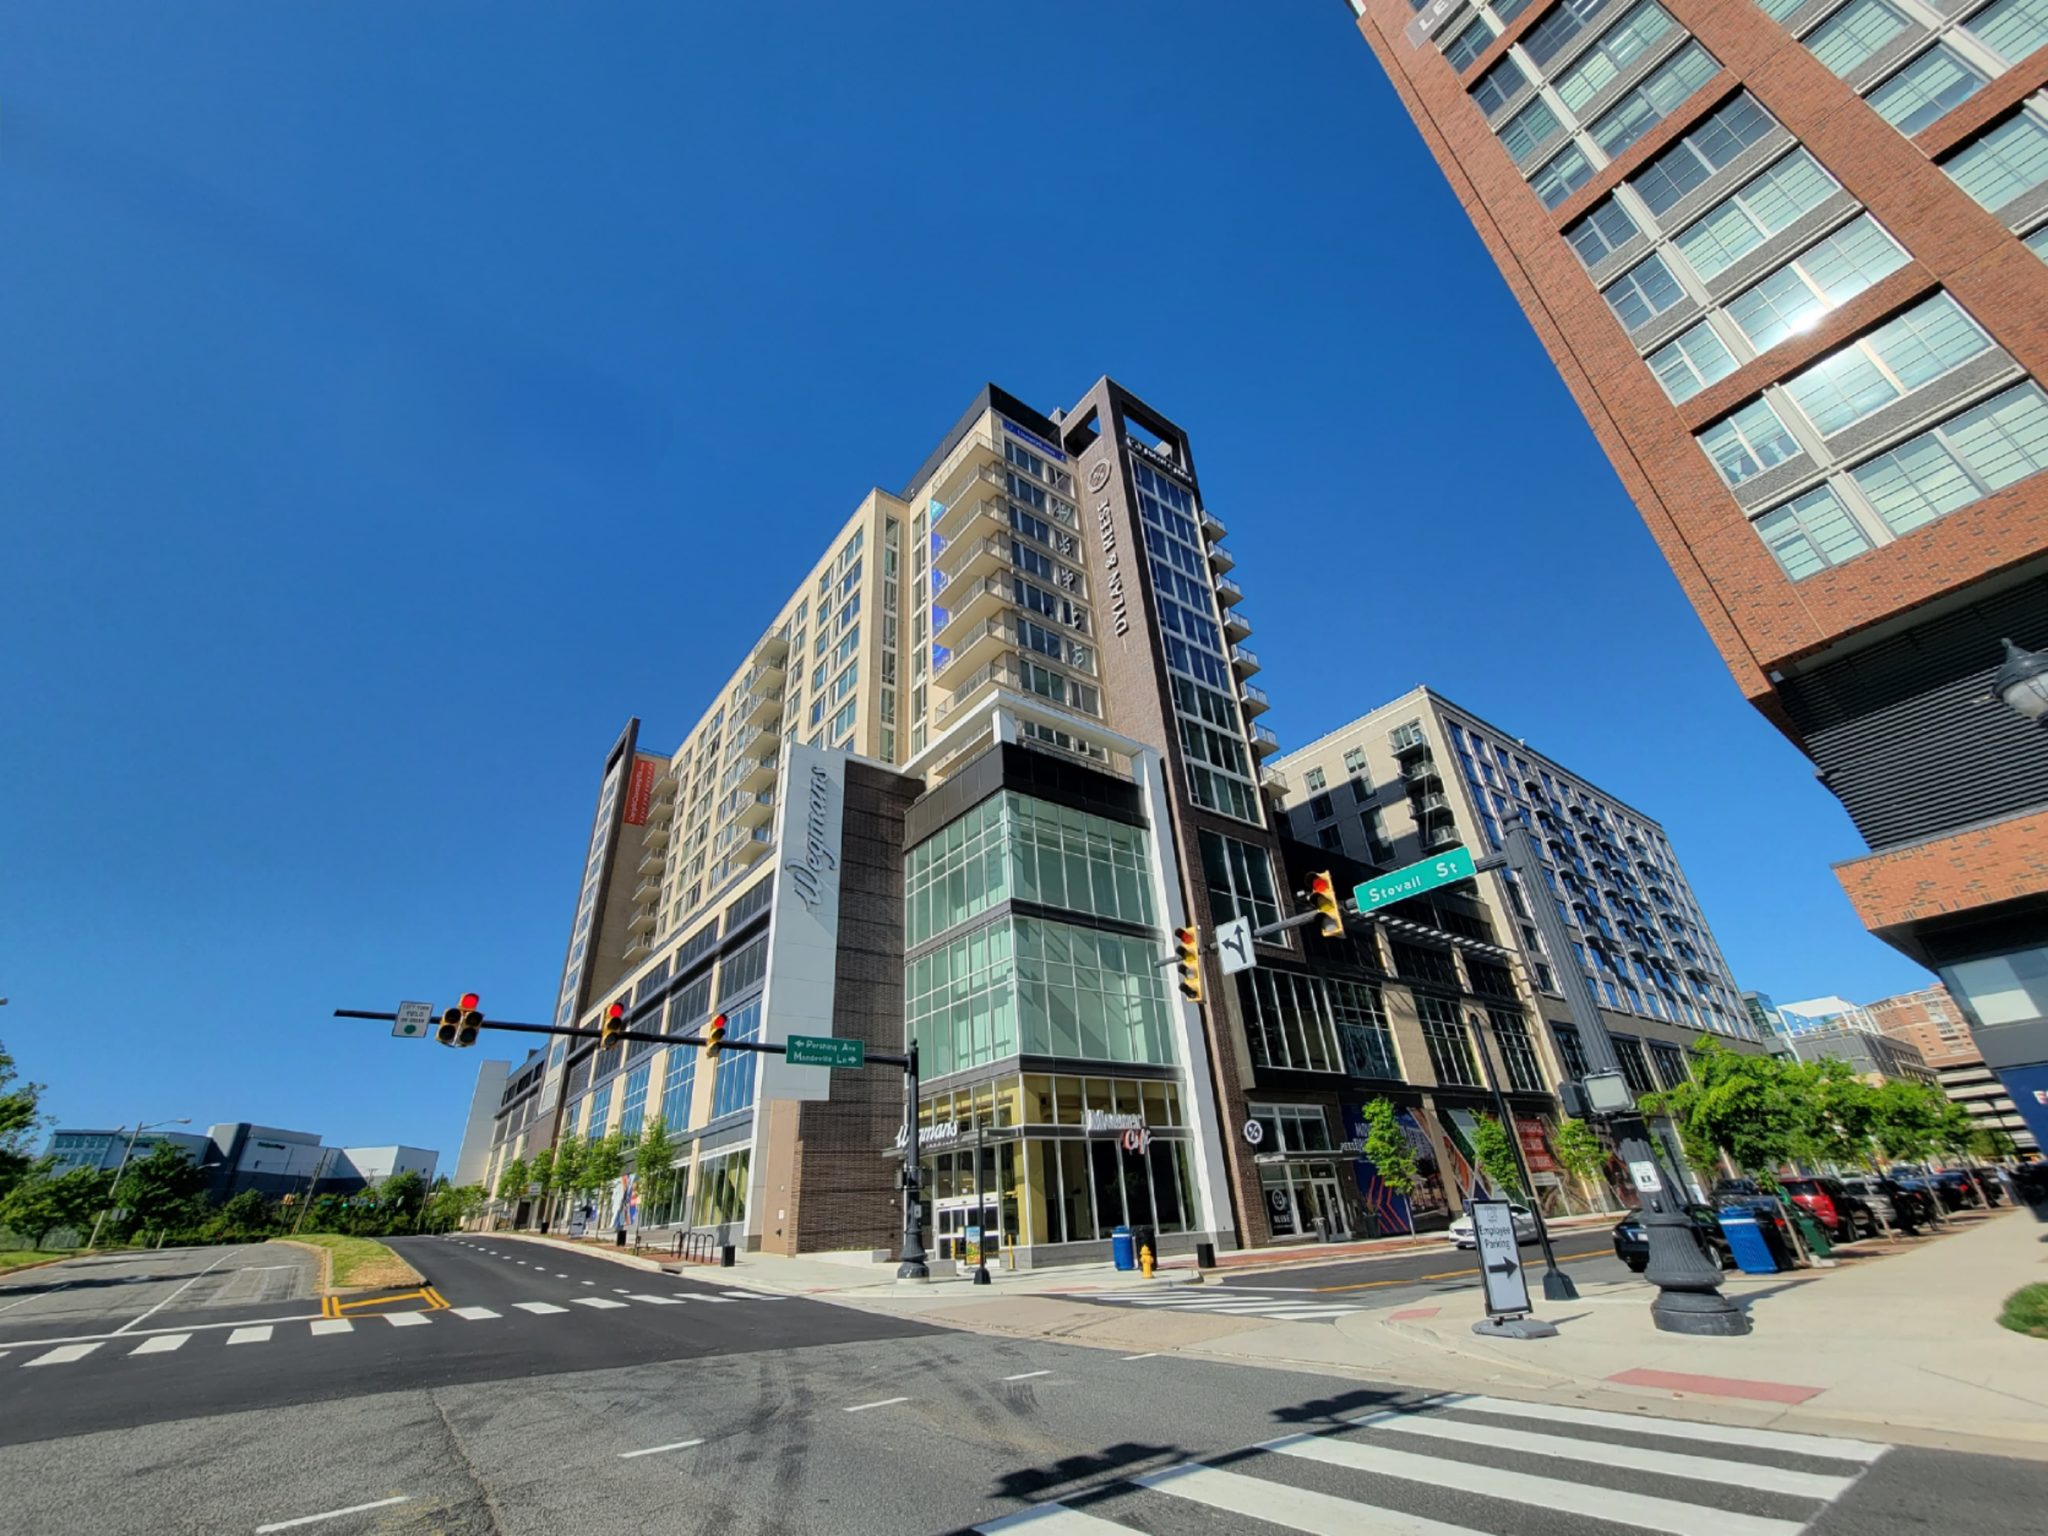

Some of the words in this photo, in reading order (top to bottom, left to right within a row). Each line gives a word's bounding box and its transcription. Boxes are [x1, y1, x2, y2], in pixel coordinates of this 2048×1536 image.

[1105, 552, 1119, 570] &
[1109, 570, 1129, 637] DYLAN
[785, 765, 838, 913] Wegmans
[1368, 876, 1421, 902] Stovall
[1436, 862, 1458, 878] St
[806, 1040, 837, 1052] Pershing
[842, 1043, 856, 1052] Ave
[836, 1054, 847, 1064] Ln
[1478, 1224, 1511, 1238] Employee
[1484, 1238, 1511, 1251] Parking
